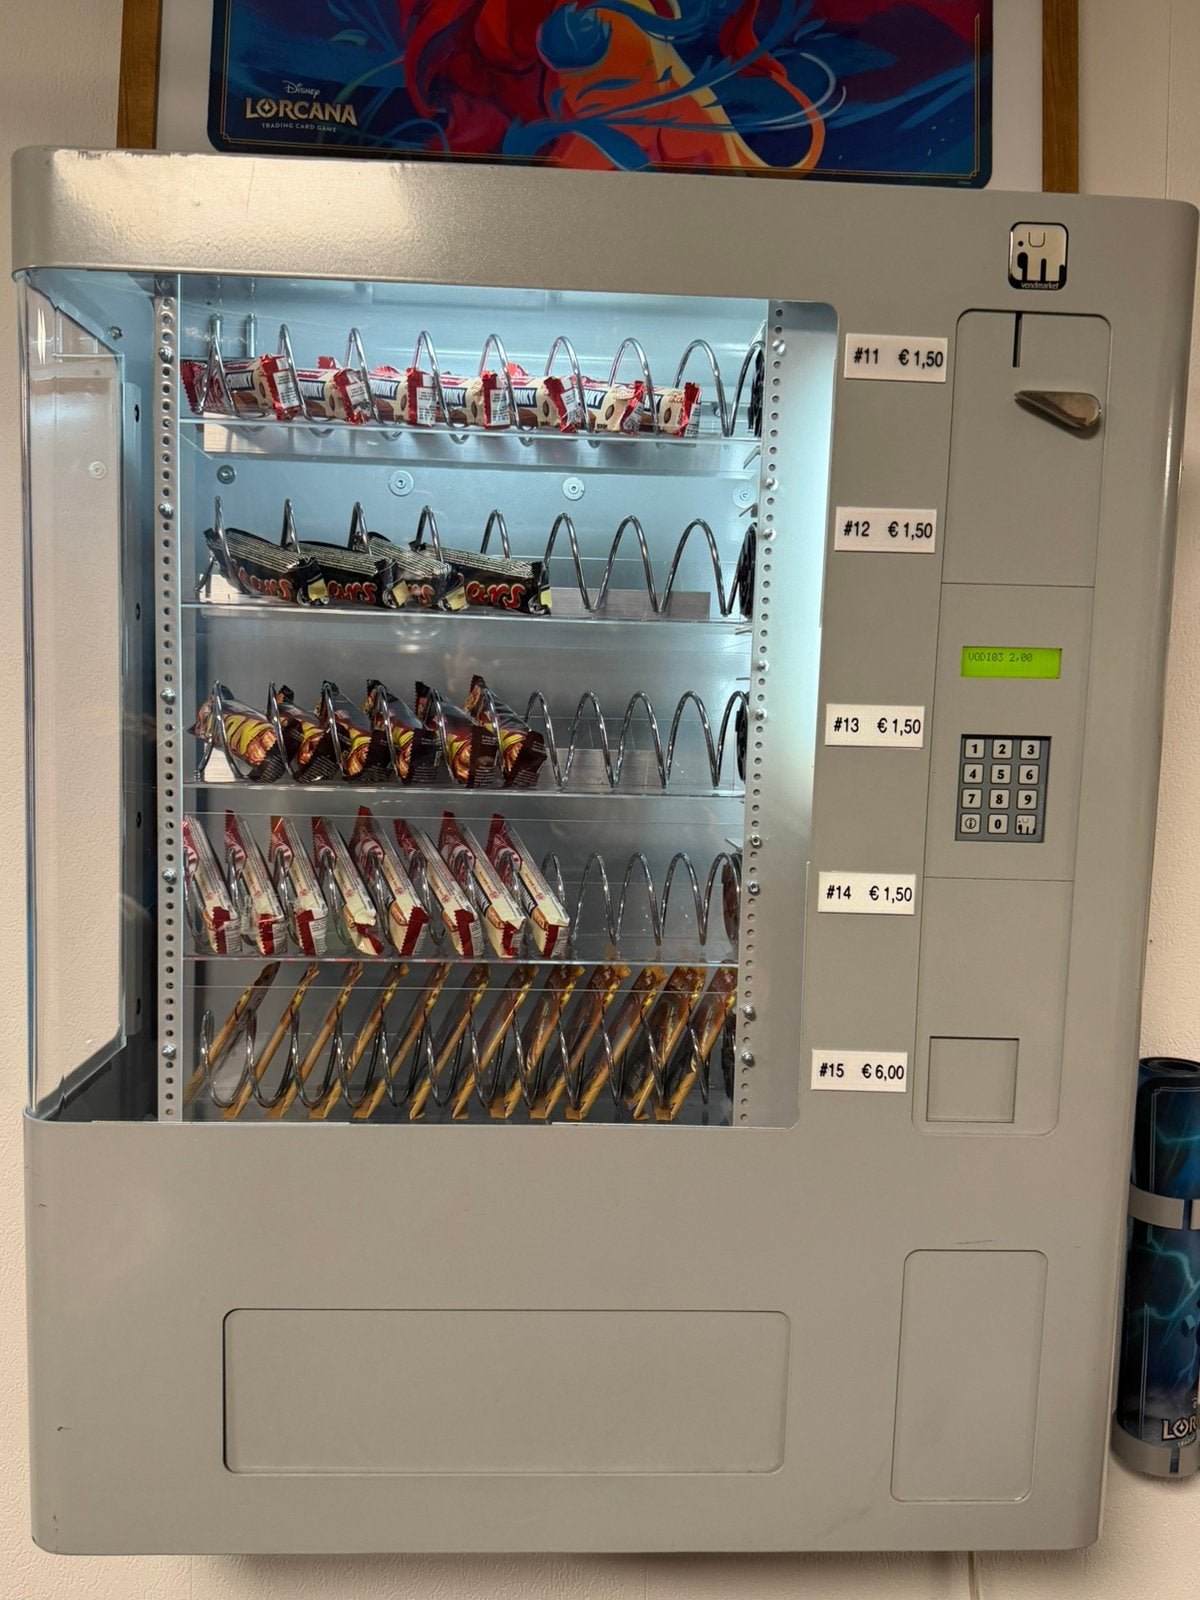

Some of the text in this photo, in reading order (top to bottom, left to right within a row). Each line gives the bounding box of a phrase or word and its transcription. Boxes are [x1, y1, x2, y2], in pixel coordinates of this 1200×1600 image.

[246, 97, 358, 126] LORCANA
[316, 125, 337, 133] GAME
[854, 346, 944, 370] #11 € 1,50
[844, 520, 933, 541] #12 € 1,50
[327, 580, 377, 604] ars
[457, 573, 526, 609] ars
[834, 717, 921, 736] #13 € 1,50
[971, 744, 1035, 755] 1 2 3
[969, 769, 1034, 780] 4 5 6
[968, 794, 1032, 805] 7 8 9
[994, 819, 1002, 830] 0
[826, 884, 913, 904] #14 € 1,50
[819, 1062, 905, 1081] #15 € 6,00
